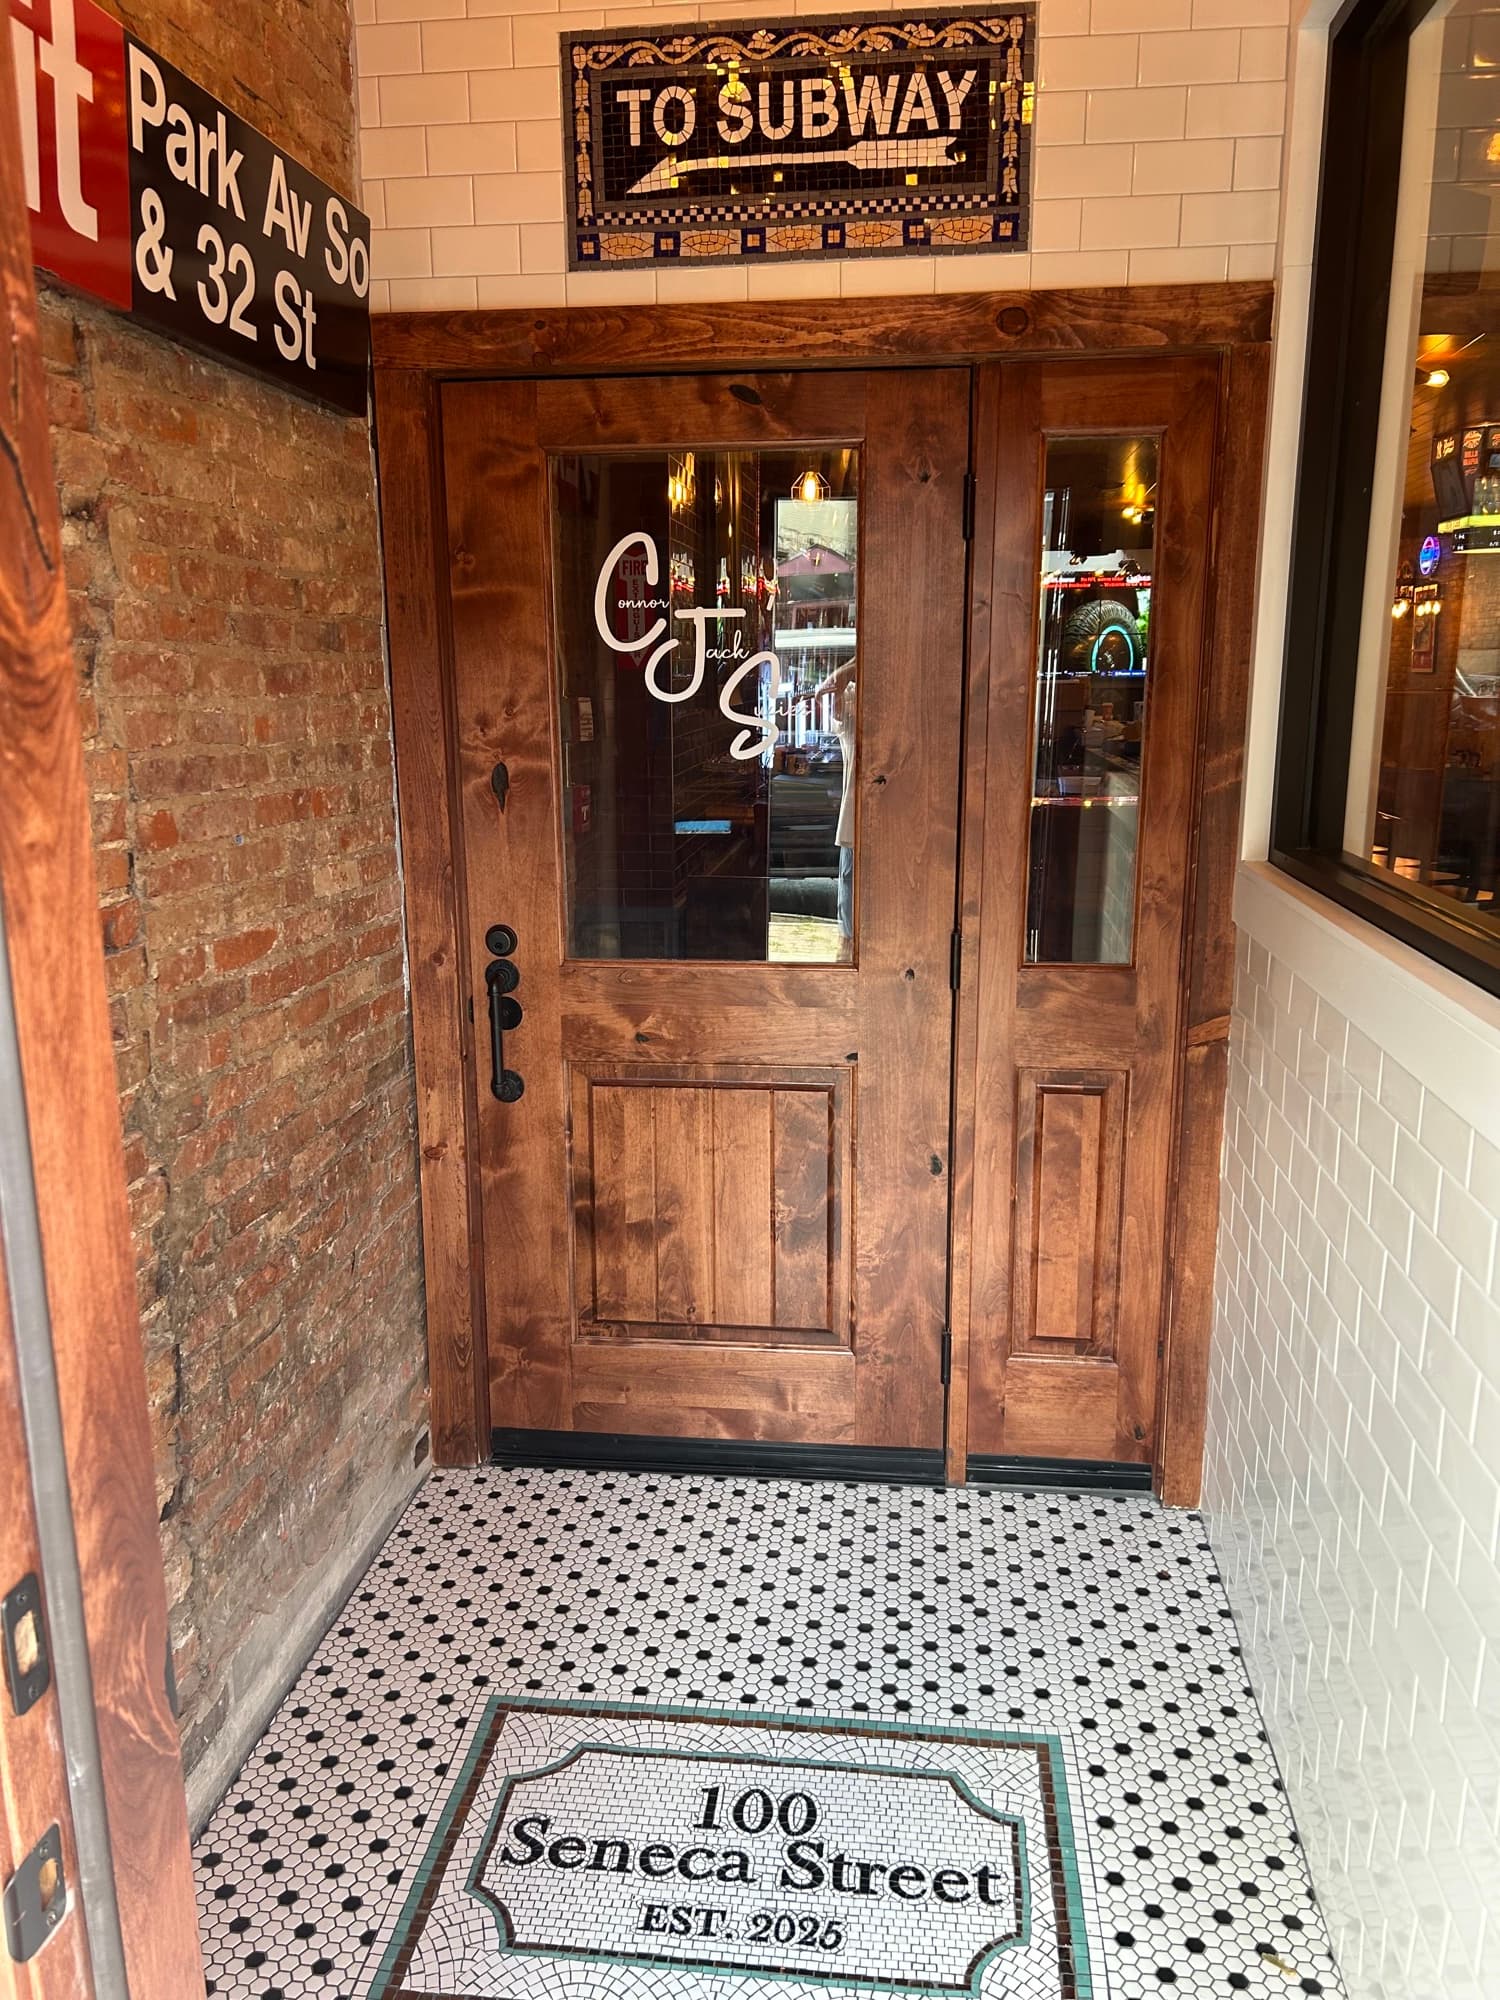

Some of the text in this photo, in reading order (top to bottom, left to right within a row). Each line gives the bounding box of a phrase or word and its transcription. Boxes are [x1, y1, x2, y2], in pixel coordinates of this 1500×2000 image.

[616, 69, 977, 146] TO SUBWAY
[129, 42, 369, 298] Park Av So
[135, 187, 317, 370] & 32 St
[693, 1784, 818, 1837] 100
[500, 1816, 1004, 1906] Seneca Street
[636, 1903, 843, 1950] EST. 2025
